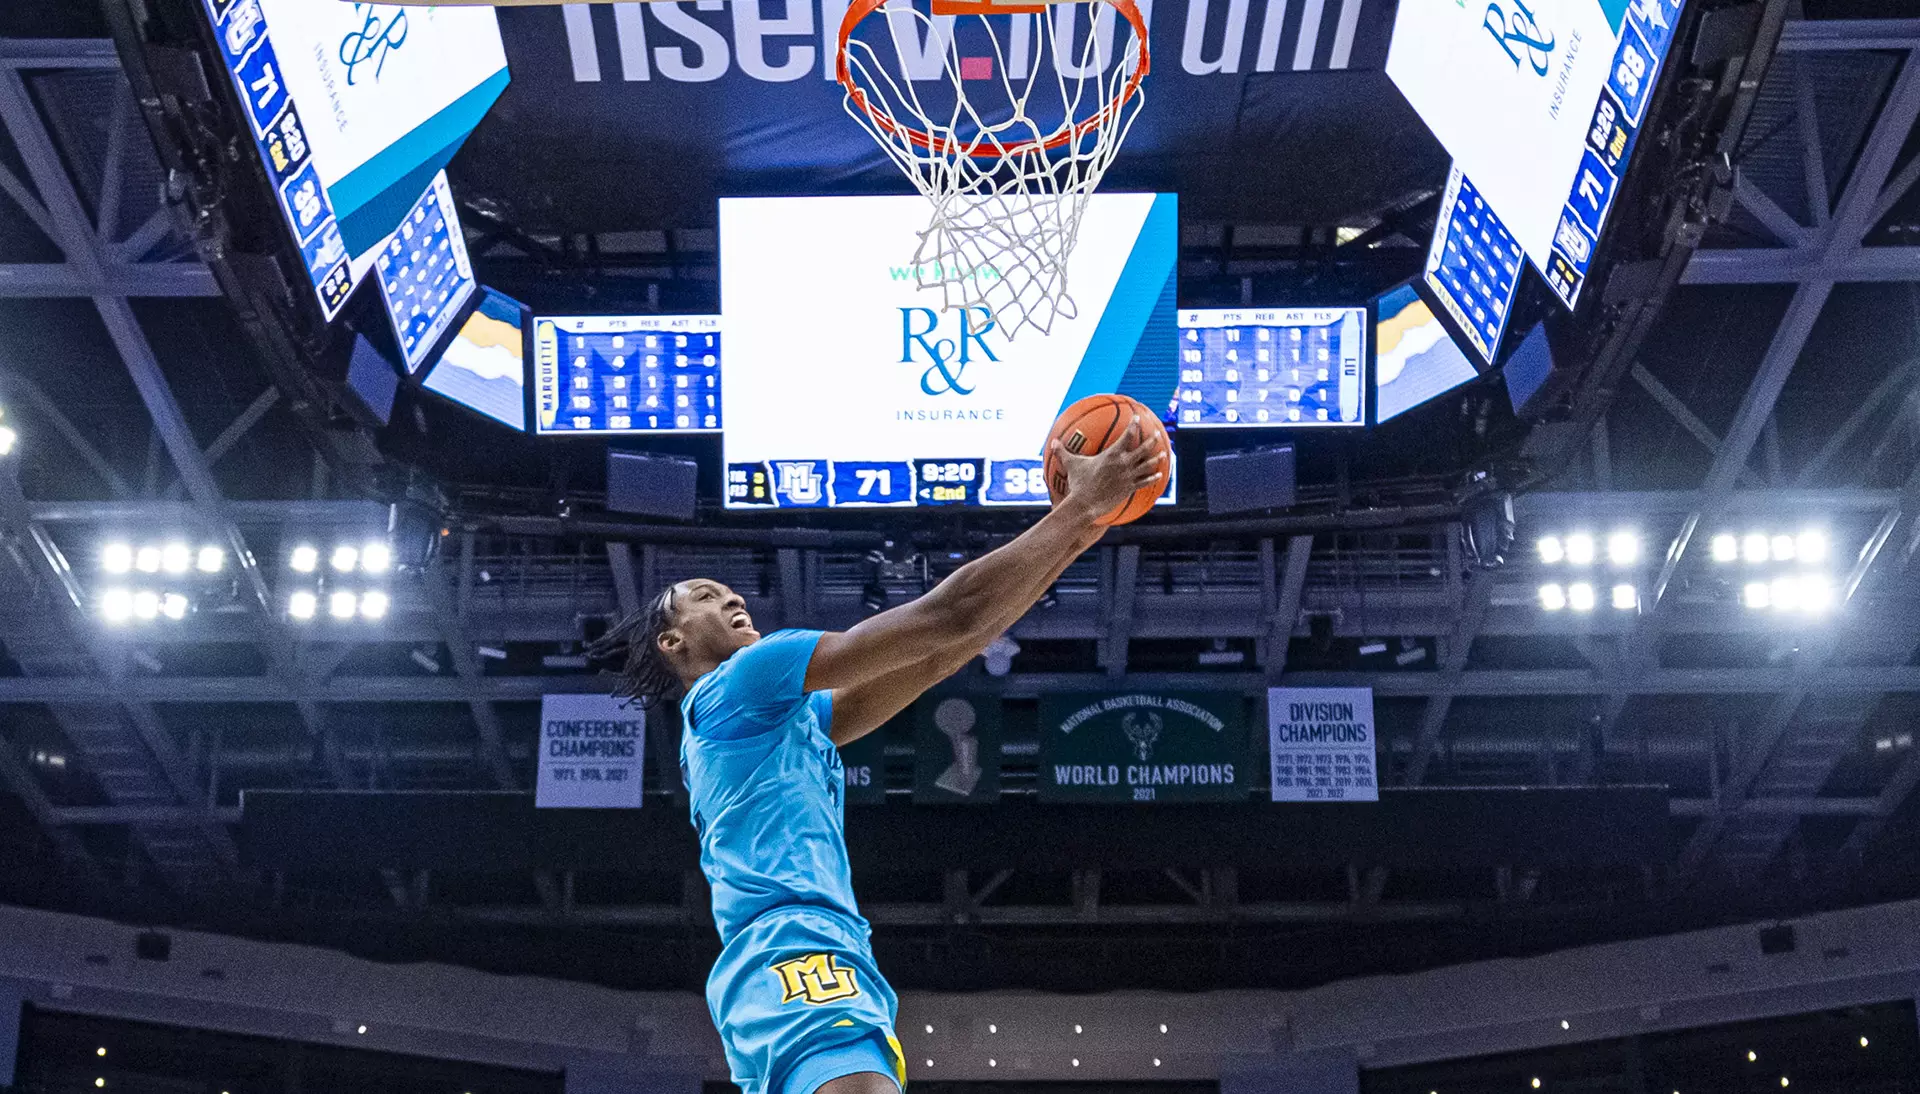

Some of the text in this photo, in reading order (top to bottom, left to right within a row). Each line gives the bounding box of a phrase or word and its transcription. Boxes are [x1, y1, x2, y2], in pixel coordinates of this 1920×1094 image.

[1549, 28, 1584, 120] INSURANCE
[1617, 44, 1646, 98] 38
[251, 62, 280, 109] 71
[314, 41, 349, 133] INSURANCE
[1579, 168, 1605, 212] 71
[294, 180, 321, 227] 38
[1558, 216, 1591, 264] MU
[889, 266, 925, 281] we
[608, 319, 628, 328] PTS
[1222, 313, 1242, 321] PTS
[1254, 312, 1275, 321] REB
[1286, 312, 1305, 321] AST
[1314, 312, 1332, 320] FLS
[576, 336, 584, 349] 1
[705, 335, 713, 347] 1
[1186, 329, 1199, 342] 4
[1226, 329, 1240, 342] 11
[1320, 328, 1328, 341] 1
[896, 306, 1002, 396] R&R
[1183, 350, 1201, 363] 10
[1226, 349, 1238, 362] 4
[1292, 349, 1299, 362] 1
[574, 356, 587, 368] 4
[612, 355, 625, 368] 4
[645, 355, 658, 368] 2
[703, 354, 716, 367] 0
[1345, 358, 1356, 376] LIU
[573, 376, 589, 389] 11
[648, 375, 656, 388] 1
[706, 375, 714, 387] 1
[1291, 368, 1299, 382] 1
[613, 395, 627, 408] 11
[646, 395, 659, 408] 4
[706, 394, 714, 408] 1
[1258, 389, 1269, 402] 7
[1319, 389, 1327, 401] 1
[649, 415, 657, 428] 1
[705, 415, 716, 427] 2
[896, 409, 1004, 421] INSURANCE
[1226, 409, 1238, 422] 0
[922, 463, 976, 482] 9:20
[777, 461, 824, 504] MU
[855, 468, 891, 496] 71
[1004, 469, 1048, 495] 38
[932, 485, 967, 500] 2nd
[1060, 694, 1225, 734] NATIONAL BASKETBALL ASSOCIATION
[1290, 703, 1354, 722] DIVISION
[546, 719, 640, 738] CONFERENCE
[1279, 723, 1368, 743] CHAMPIONS
[549, 740, 636, 757] CHAMPIONS
[1054, 764, 1234, 786] WORLD CHAMPIONS
[1132, 788, 1156, 800] 2021
[768, 954, 862, 1005] MU
